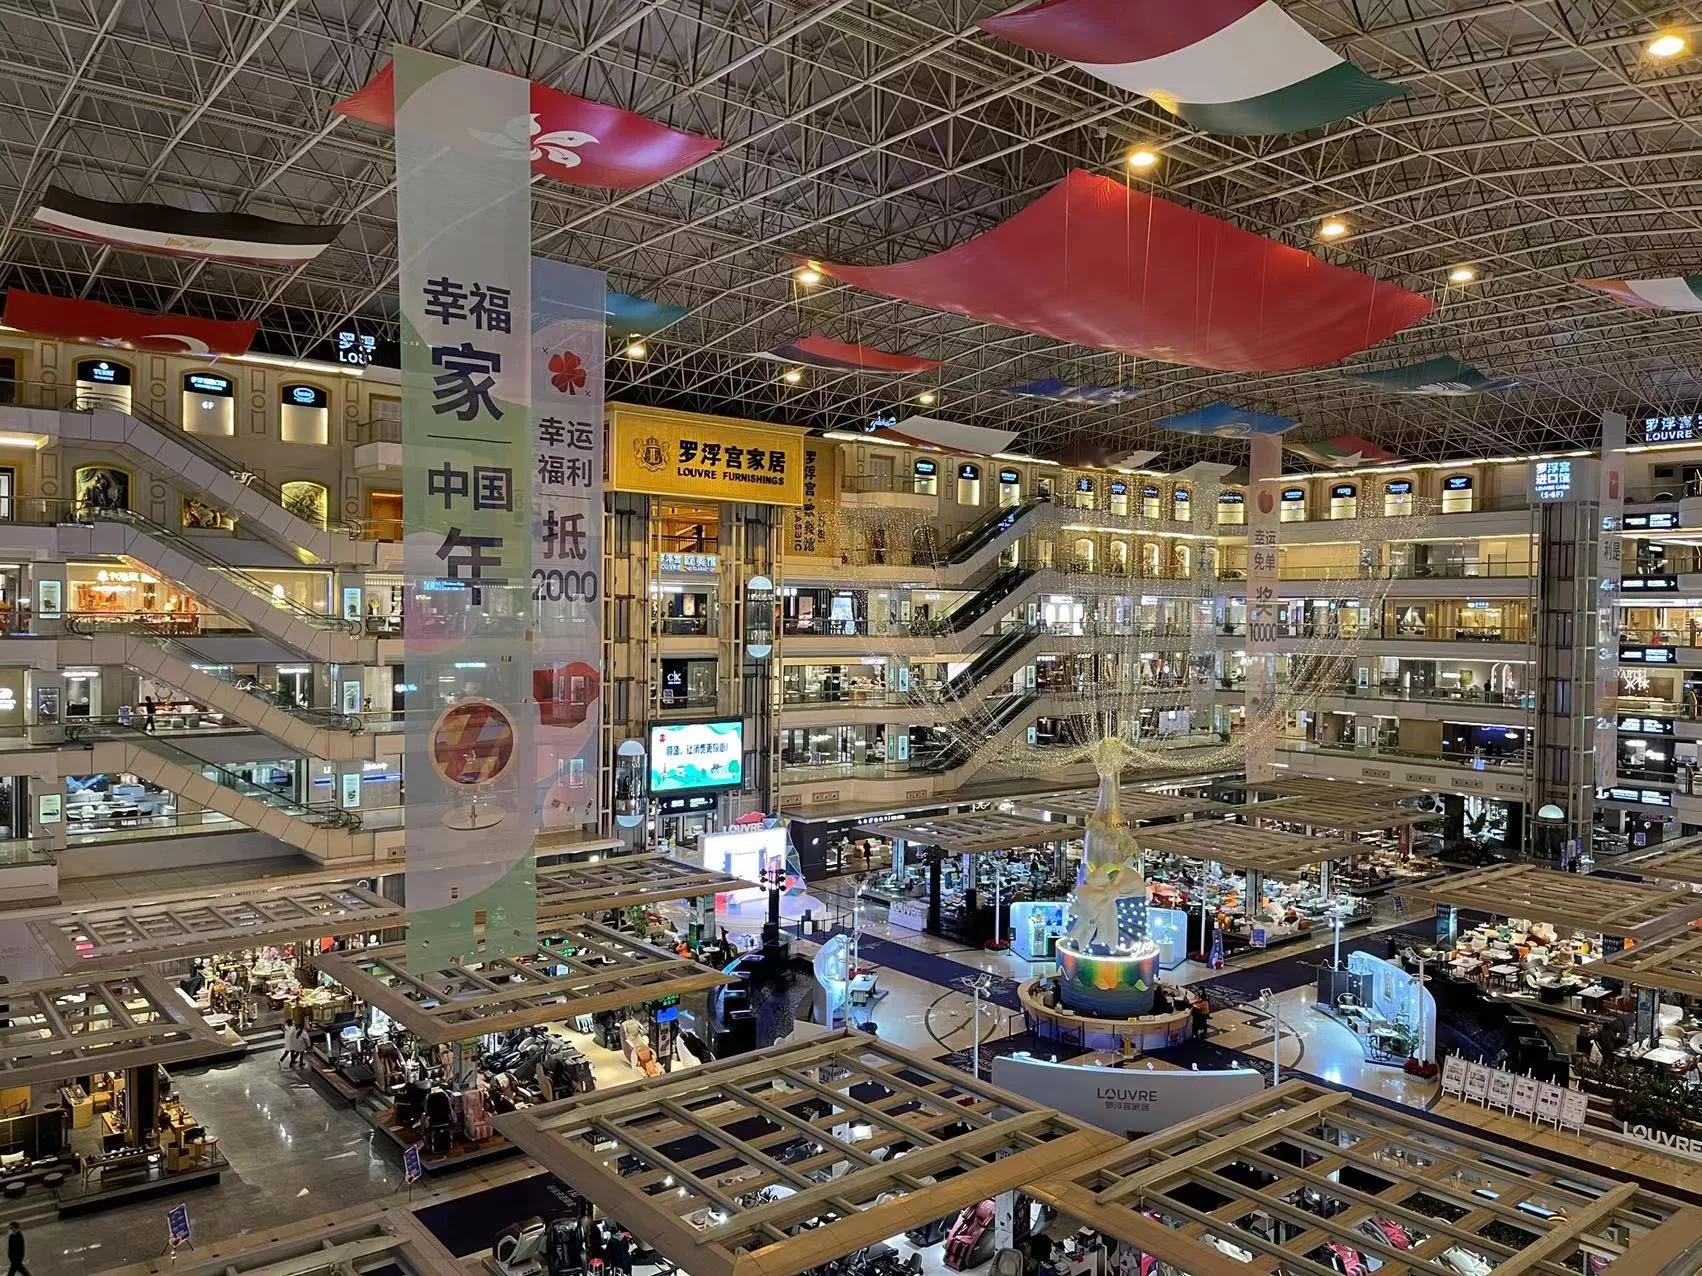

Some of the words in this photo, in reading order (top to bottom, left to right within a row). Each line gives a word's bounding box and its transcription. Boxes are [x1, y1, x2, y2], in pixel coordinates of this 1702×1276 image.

[423, 277, 511, 334] 幸福
[432, 343, 504, 421] 家
[539, 417, 593, 450] 幸运
[1645, 430, 1692, 441] LOUVRE
[538, 454, 593, 488] 福利
[679, 440, 785, 474] 罗浮宫家居
[1536, 462, 1571, 474] 罗浮宫
[428, 462, 513, 512] 中国
[678, 467, 717, 479] LOUVRE
[723, 472, 785, 486] FURNISHINGS
[542, 510, 588, 561] 抵
[1255, 531, 1276, 548] 幸运
[435, 526, 508, 605] 年
[1254, 553, 1276, 571] 免单
[532, 568, 598, 603] 2000
[1250, 622, 1277, 642] 10000
[723, 822, 765, 834] LOUVRE
[1097, 1087, 1158, 1102] LOUVRE
[1623, 1121, 1702, 1153] LOUVRE
